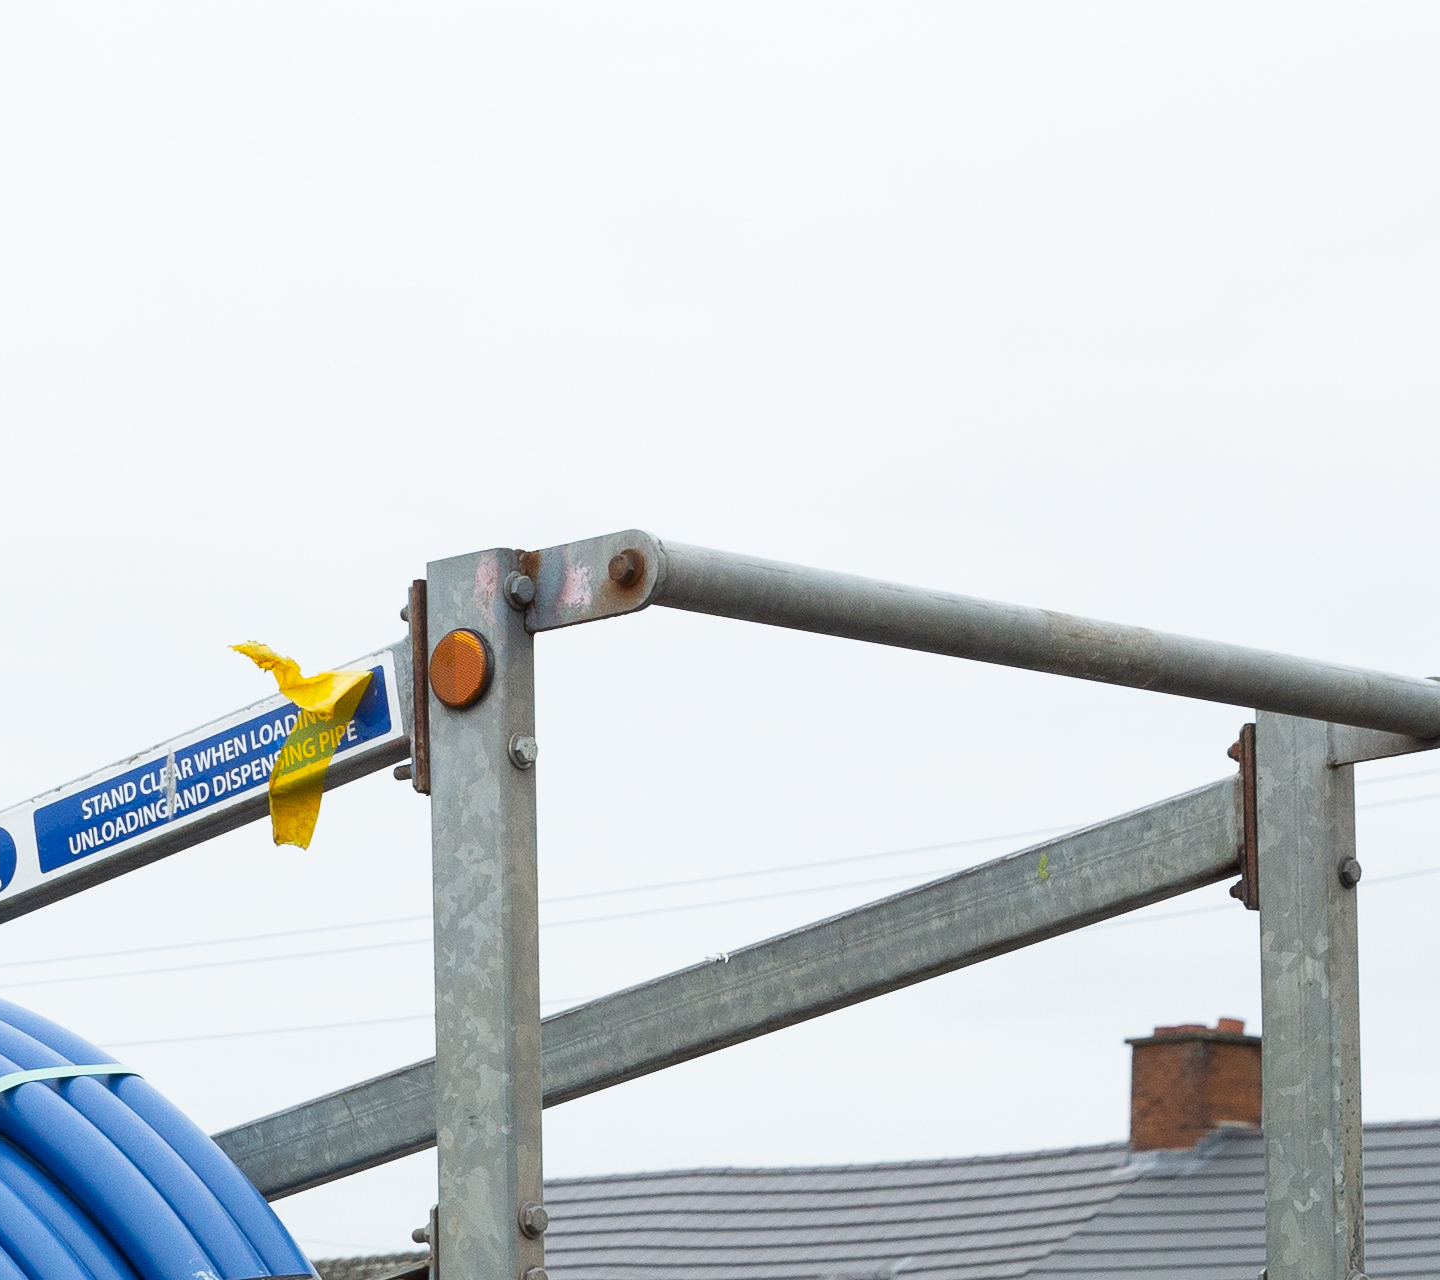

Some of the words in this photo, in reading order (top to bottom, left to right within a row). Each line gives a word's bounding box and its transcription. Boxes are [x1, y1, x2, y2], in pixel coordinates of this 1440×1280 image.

[69, 796, 169, 855] UNLOADING
[172, 780, 210, 814] AND
[213, 737, 316, 797] DISPENSING
[320, 720, 358, 754] PIPE
[82, 780, 137, 819] STAND
[140, 757, 192, 796] CLEAR
[195, 735, 247, 775] WHEN
